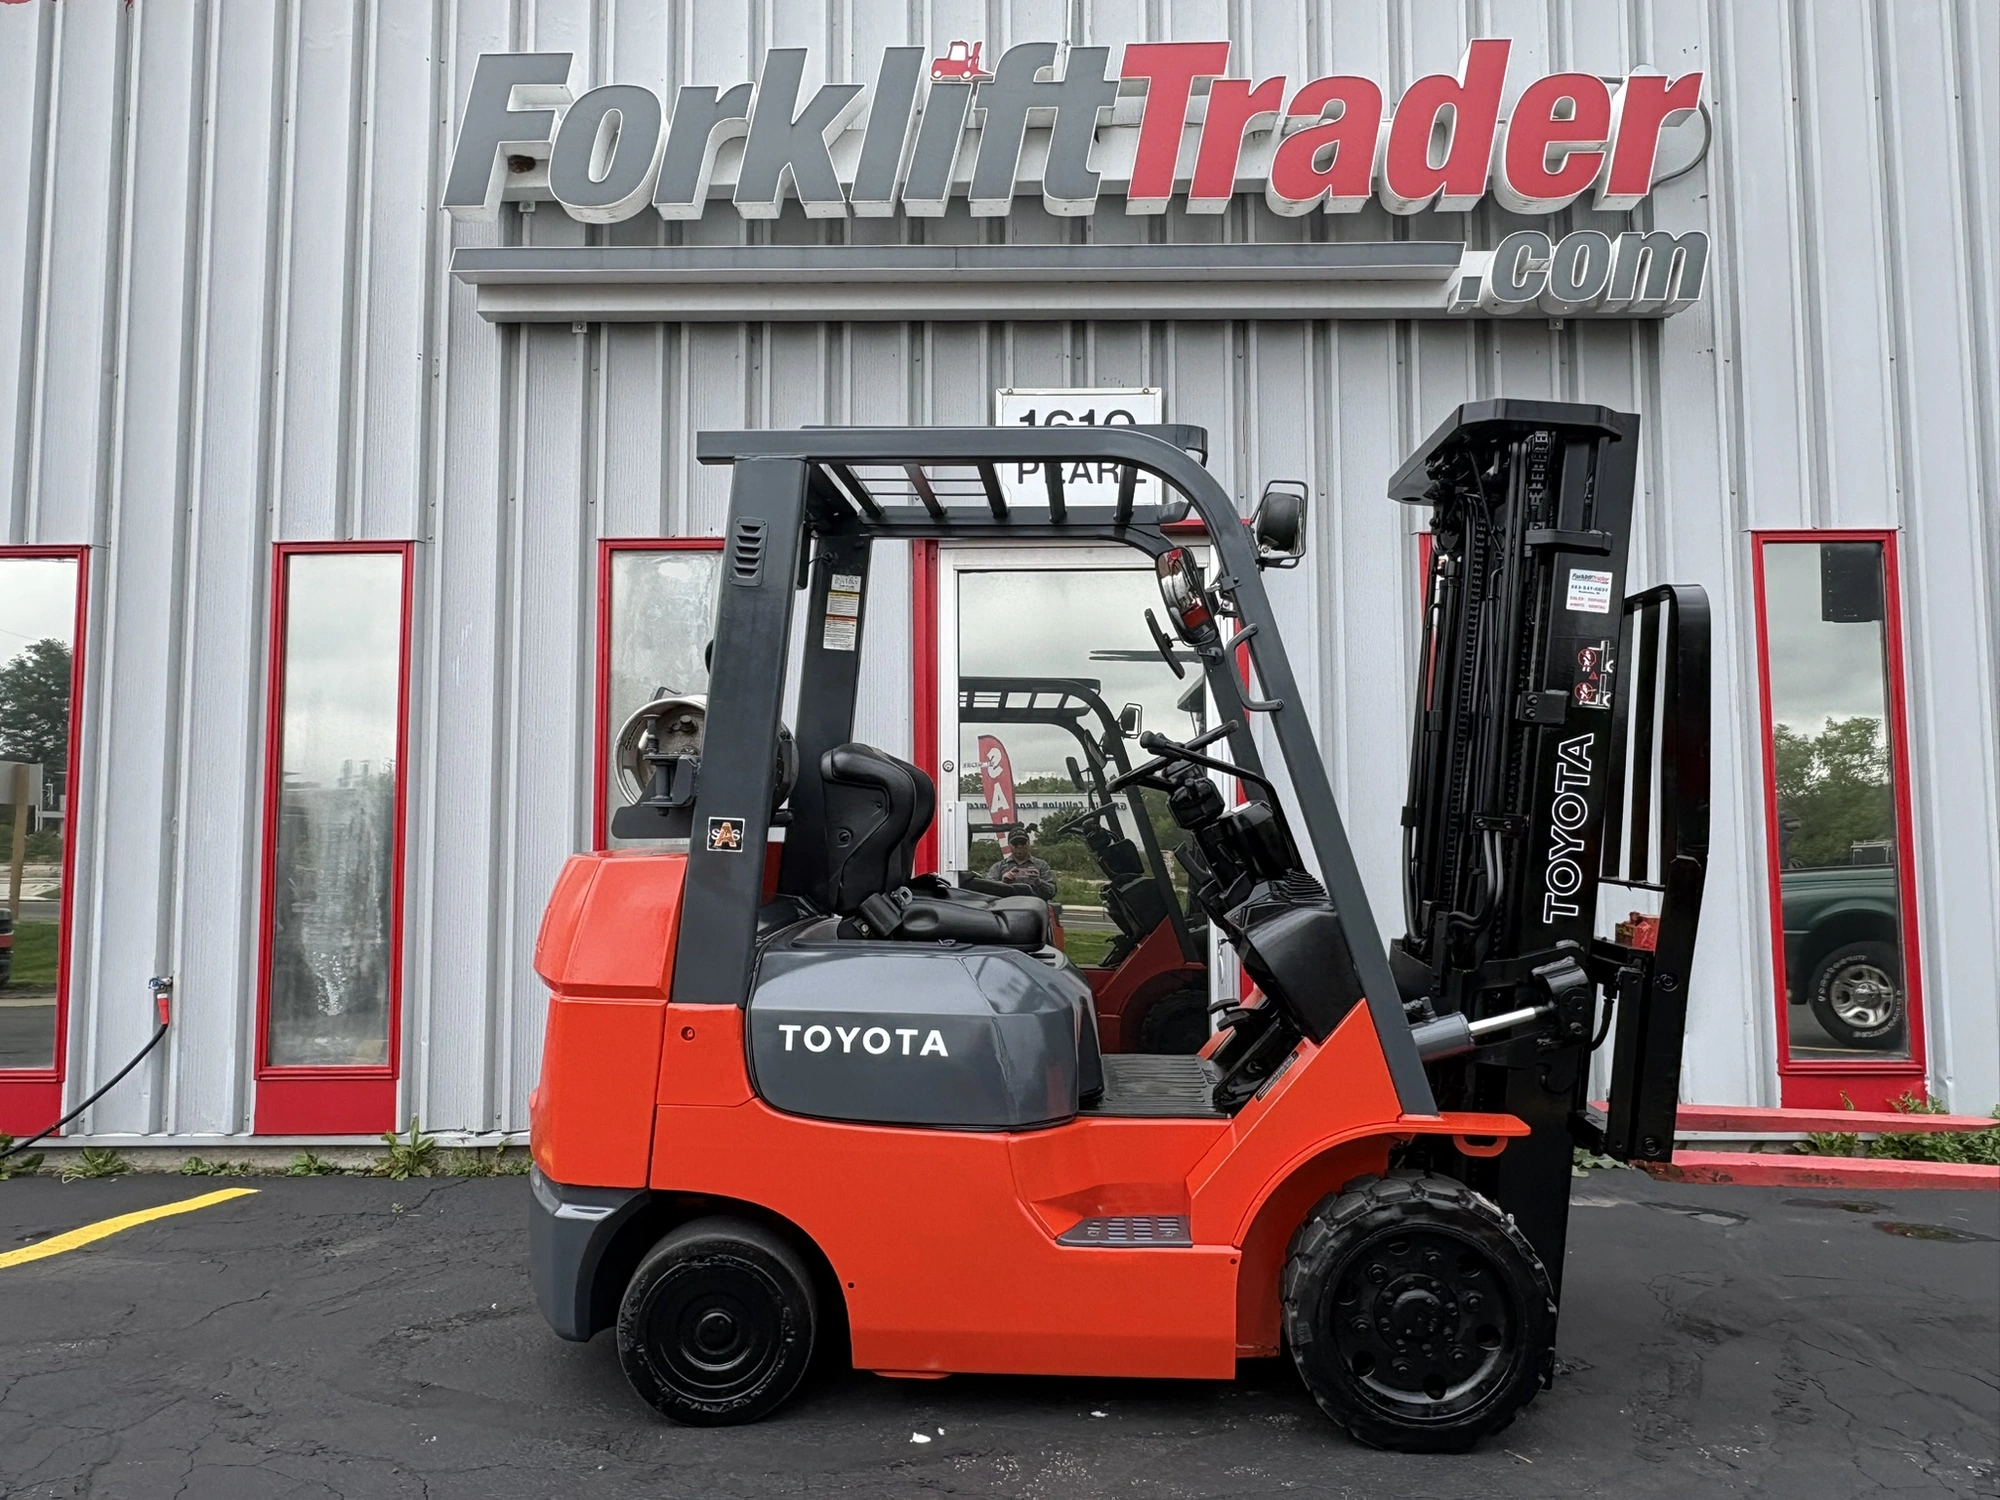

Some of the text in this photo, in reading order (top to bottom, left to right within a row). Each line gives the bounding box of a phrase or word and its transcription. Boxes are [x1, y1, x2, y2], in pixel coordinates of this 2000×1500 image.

[1456, 230, 1710, 305] .com
[1543, 732, 1595, 924] TOYOTA
[778, 1024, 949, 1057] TOYOTA
